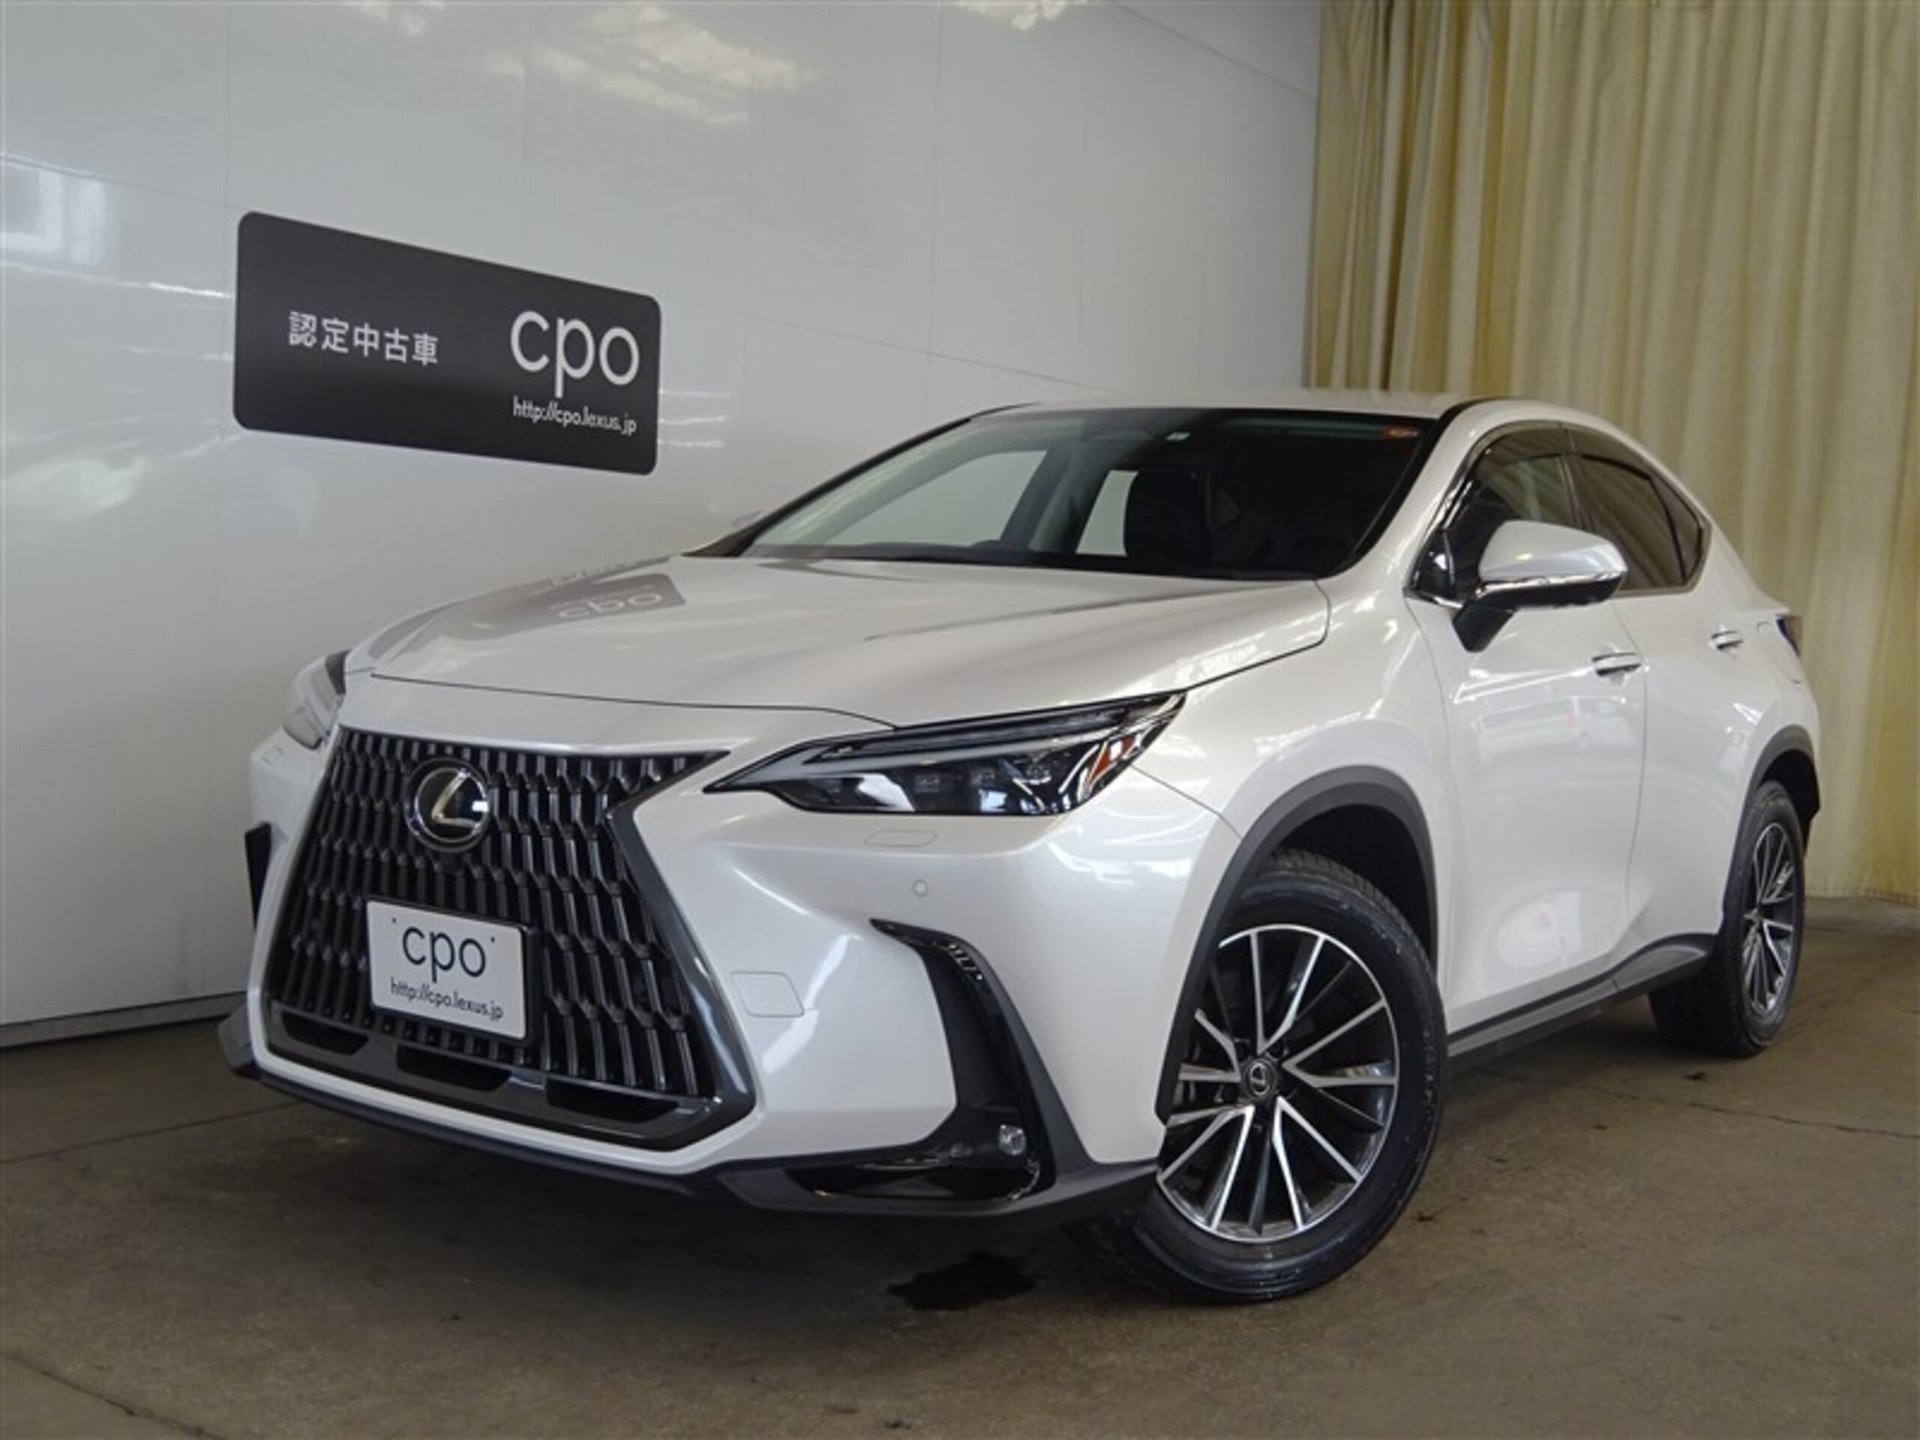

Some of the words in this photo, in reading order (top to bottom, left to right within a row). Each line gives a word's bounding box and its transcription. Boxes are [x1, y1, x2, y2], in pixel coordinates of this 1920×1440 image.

[288, 311, 439, 366] 認定中古車
[510, 310, 640, 399] cpo
[512, 395, 637, 436] http://cpo.lexus.jp
[402, 926, 486, 983] cpo
